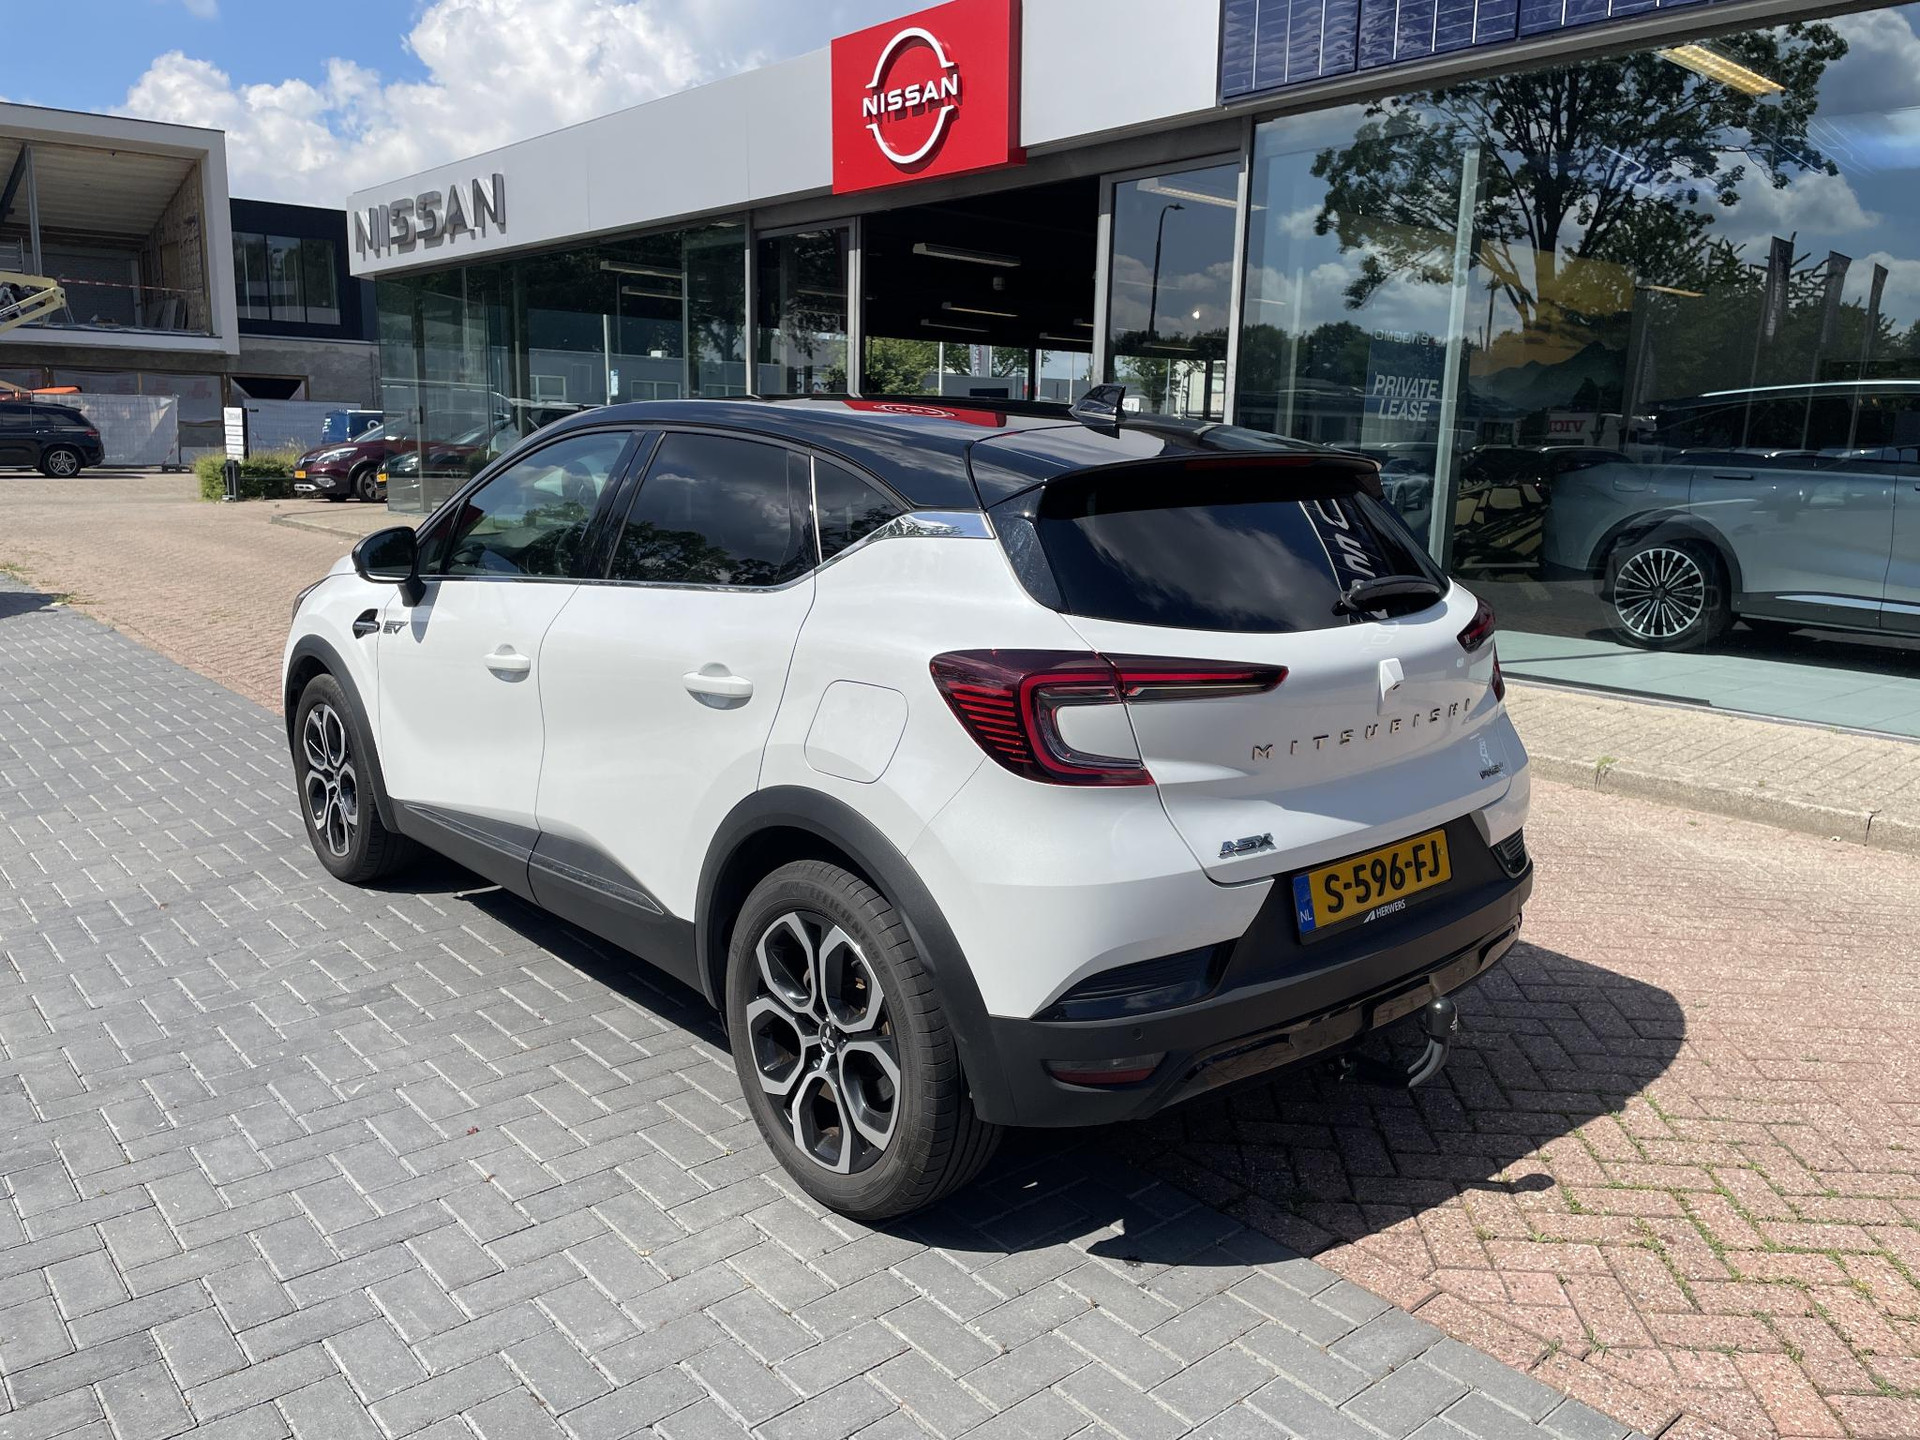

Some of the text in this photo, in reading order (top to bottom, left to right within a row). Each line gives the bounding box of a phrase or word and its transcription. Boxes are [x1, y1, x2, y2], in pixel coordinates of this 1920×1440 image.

[862, 73, 958, 118] NISSAN
[354, 173, 506, 255] NISSAN
[1372, 374, 1439, 399] PRIVATE
[1378, 399, 1430, 421] LEASE
[1252, 698, 1470, 761] MITSUBISHI
[1217, 832, 1277, 859] ASX
[1324, 840, 1440, 914] S-596-FJ
[1299, 909, 1314, 924] NL
[1376, 899, 1406, 919] HERWERS
